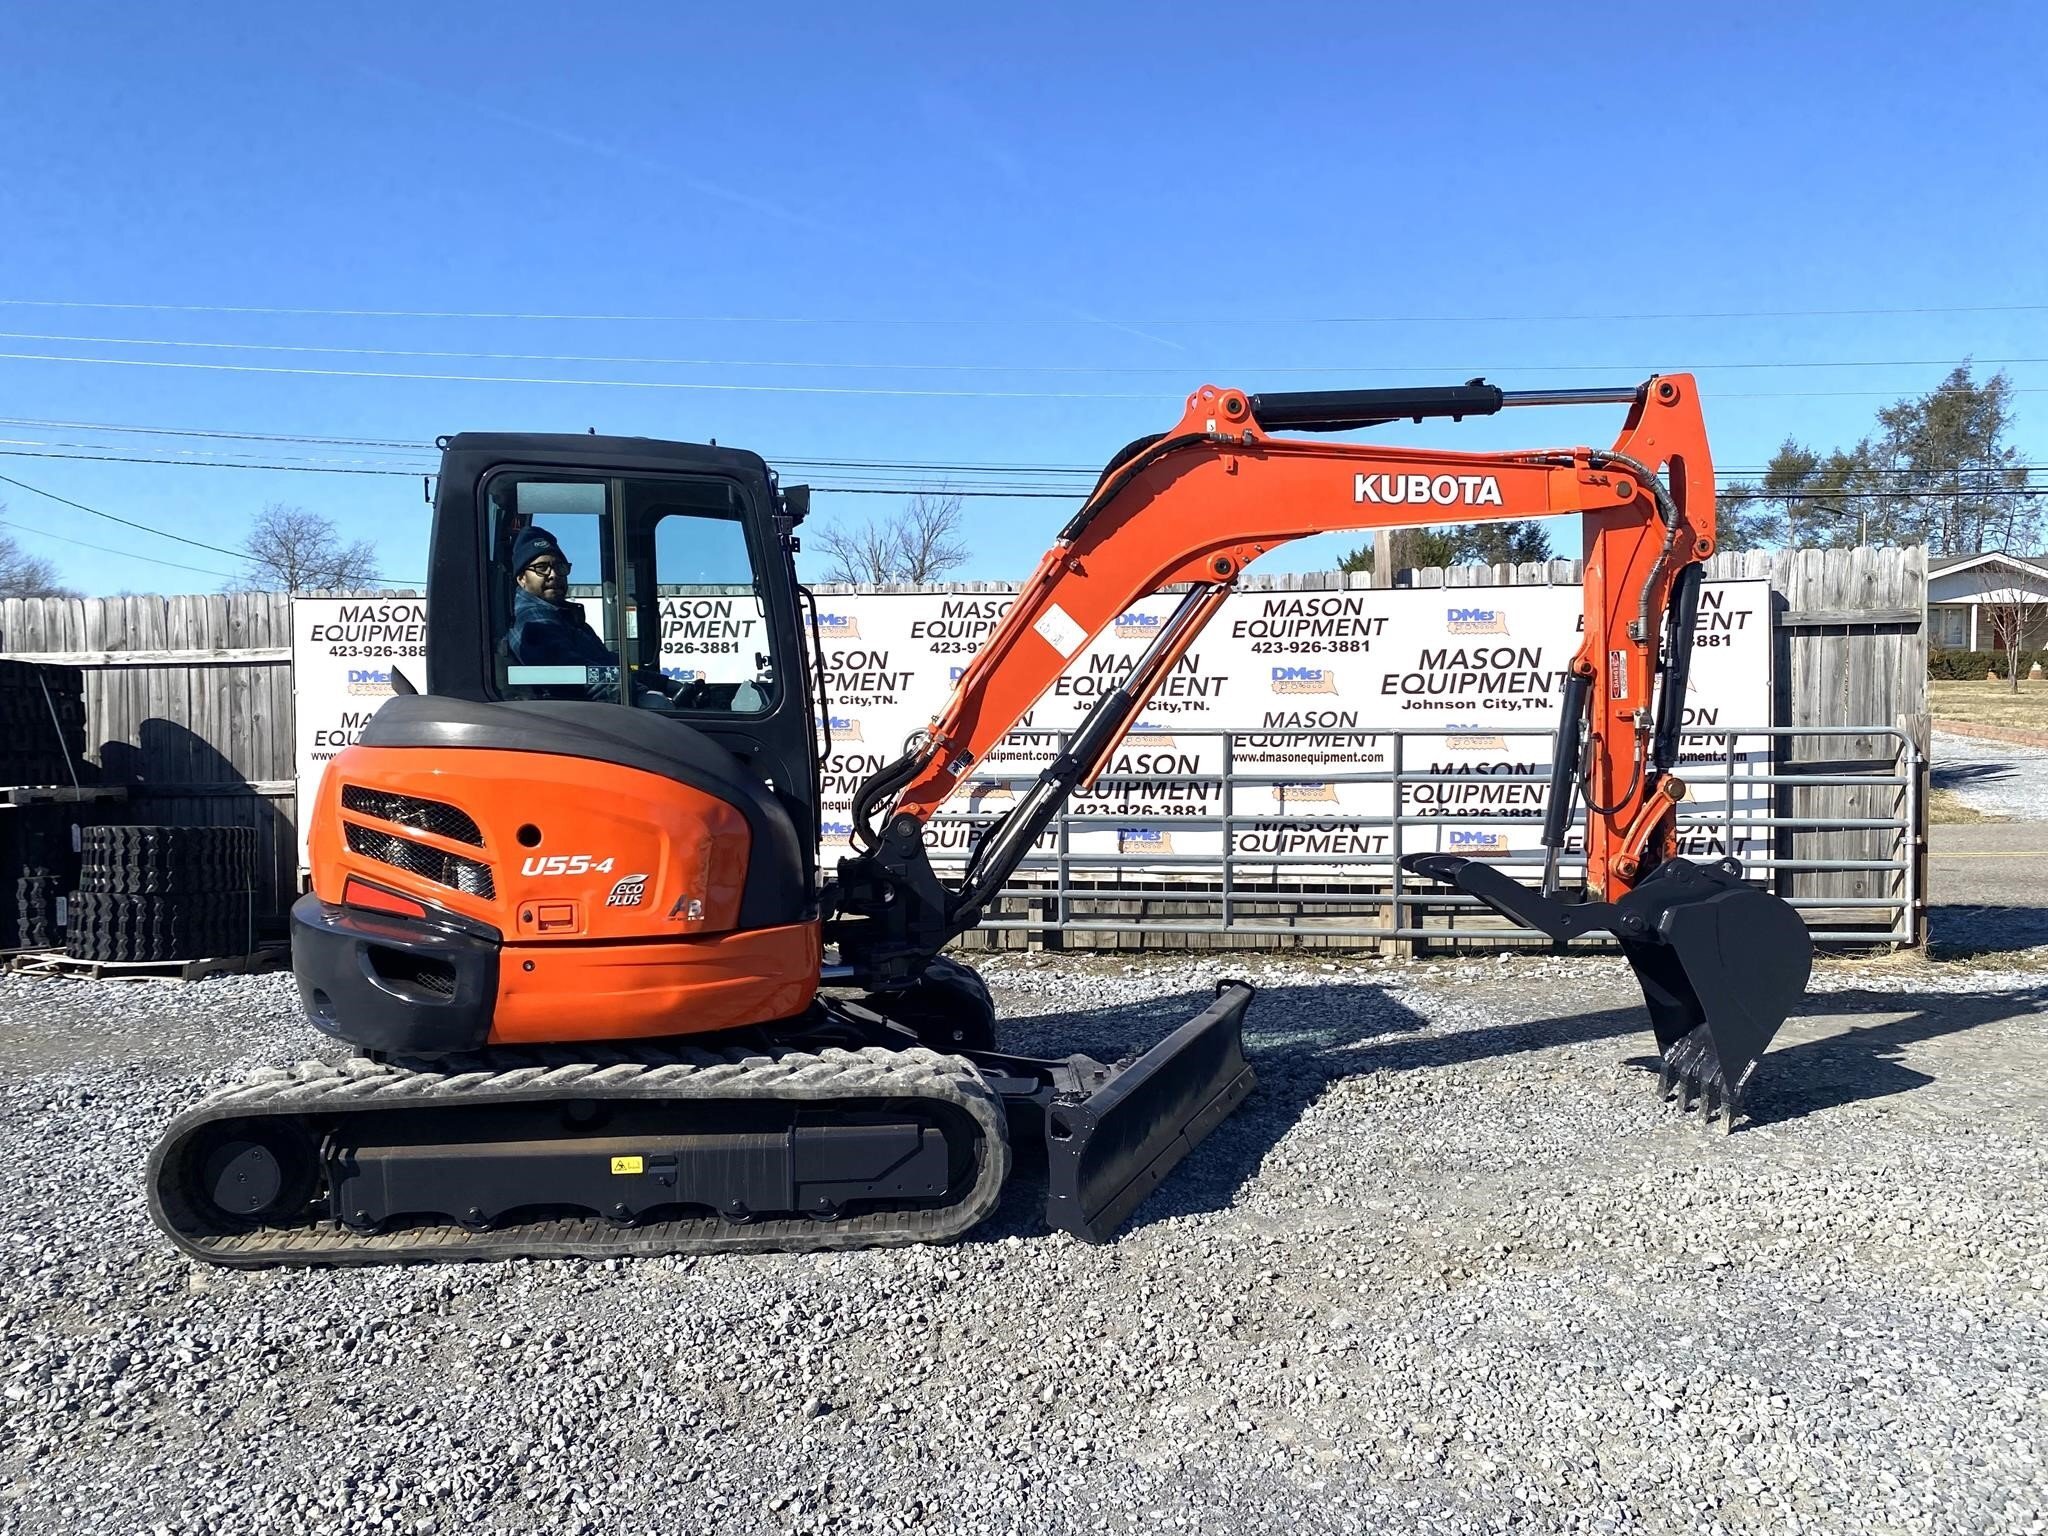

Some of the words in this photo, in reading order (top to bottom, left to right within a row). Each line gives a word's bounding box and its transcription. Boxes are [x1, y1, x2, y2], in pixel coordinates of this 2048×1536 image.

[1354, 474, 1503, 505] KUBOTA
[659, 600, 732, 619] ASON
[1262, 598, 1363, 617] MASON
[310, 625, 427, 642] EQUIPME
[661, 620, 756, 638] IPMENT
[1232, 618, 1389, 638] EQUIPMENT
[329, 645, 427, 657] 423-926-388
[660, 642, 739, 654] -926-3881
[1251, 640, 1370, 653] 423-926-3881
[809, 651, 888, 670] ASON
[1089, 654, 1200, 673] MAN
[1419, 647, 1542, 670] MASON
[1402, 700, 1476, 709] Johnson
[1482, 698, 1553, 711] City,TN.
[1262, 711, 1358, 728] MASON
[820, 755, 885, 773] ASON
[1402, 784, 1552, 804] EQUIPMEN
[521, 855, 615, 876] U55-4
[605, 895, 642, 906] PLUS
